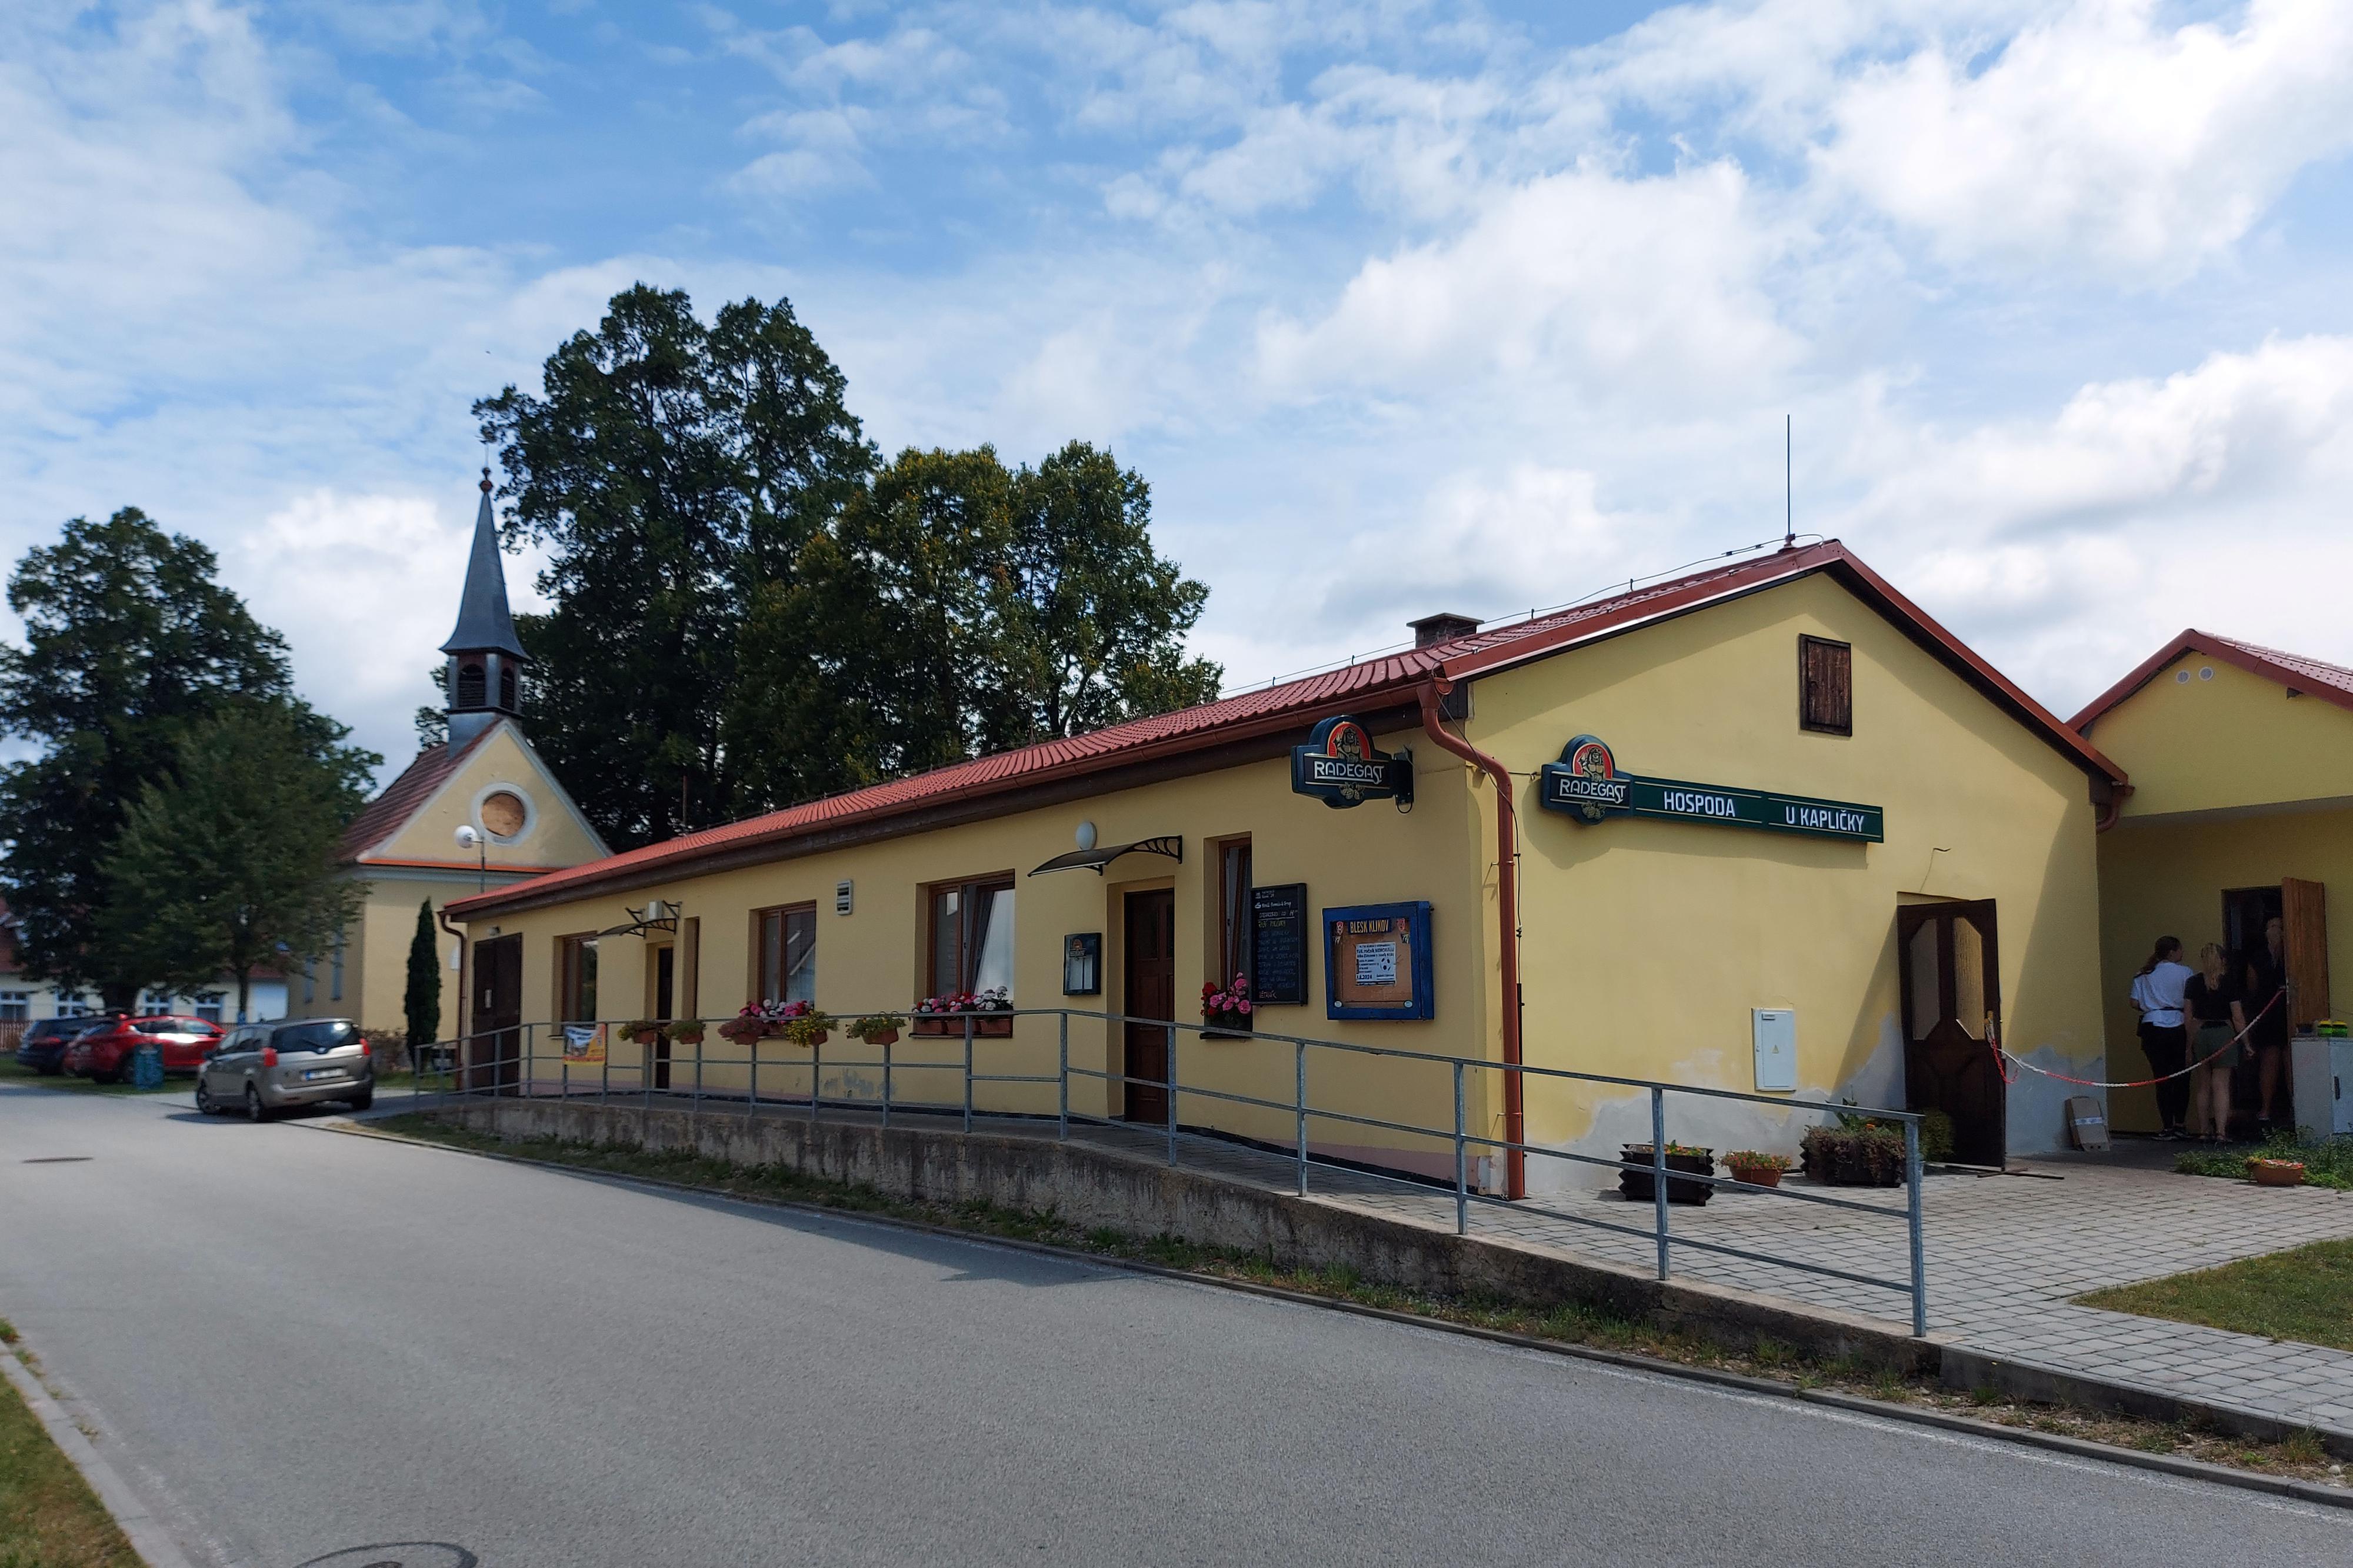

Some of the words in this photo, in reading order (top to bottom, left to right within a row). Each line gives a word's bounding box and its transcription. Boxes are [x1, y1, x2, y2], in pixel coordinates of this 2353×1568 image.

[1314, 760, 1384, 785] RADEGAST
[1559, 778, 1627, 804] RADEGAST
[1664, 791, 1736, 818] HOSPODA
[1786, 806, 1795, 824] U
[1800, 809, 1865, 832] KAPLIČKY
[1350, 920, 1368, 933] BLESK
[1369, 919, 1389, 933] KLIKOV
